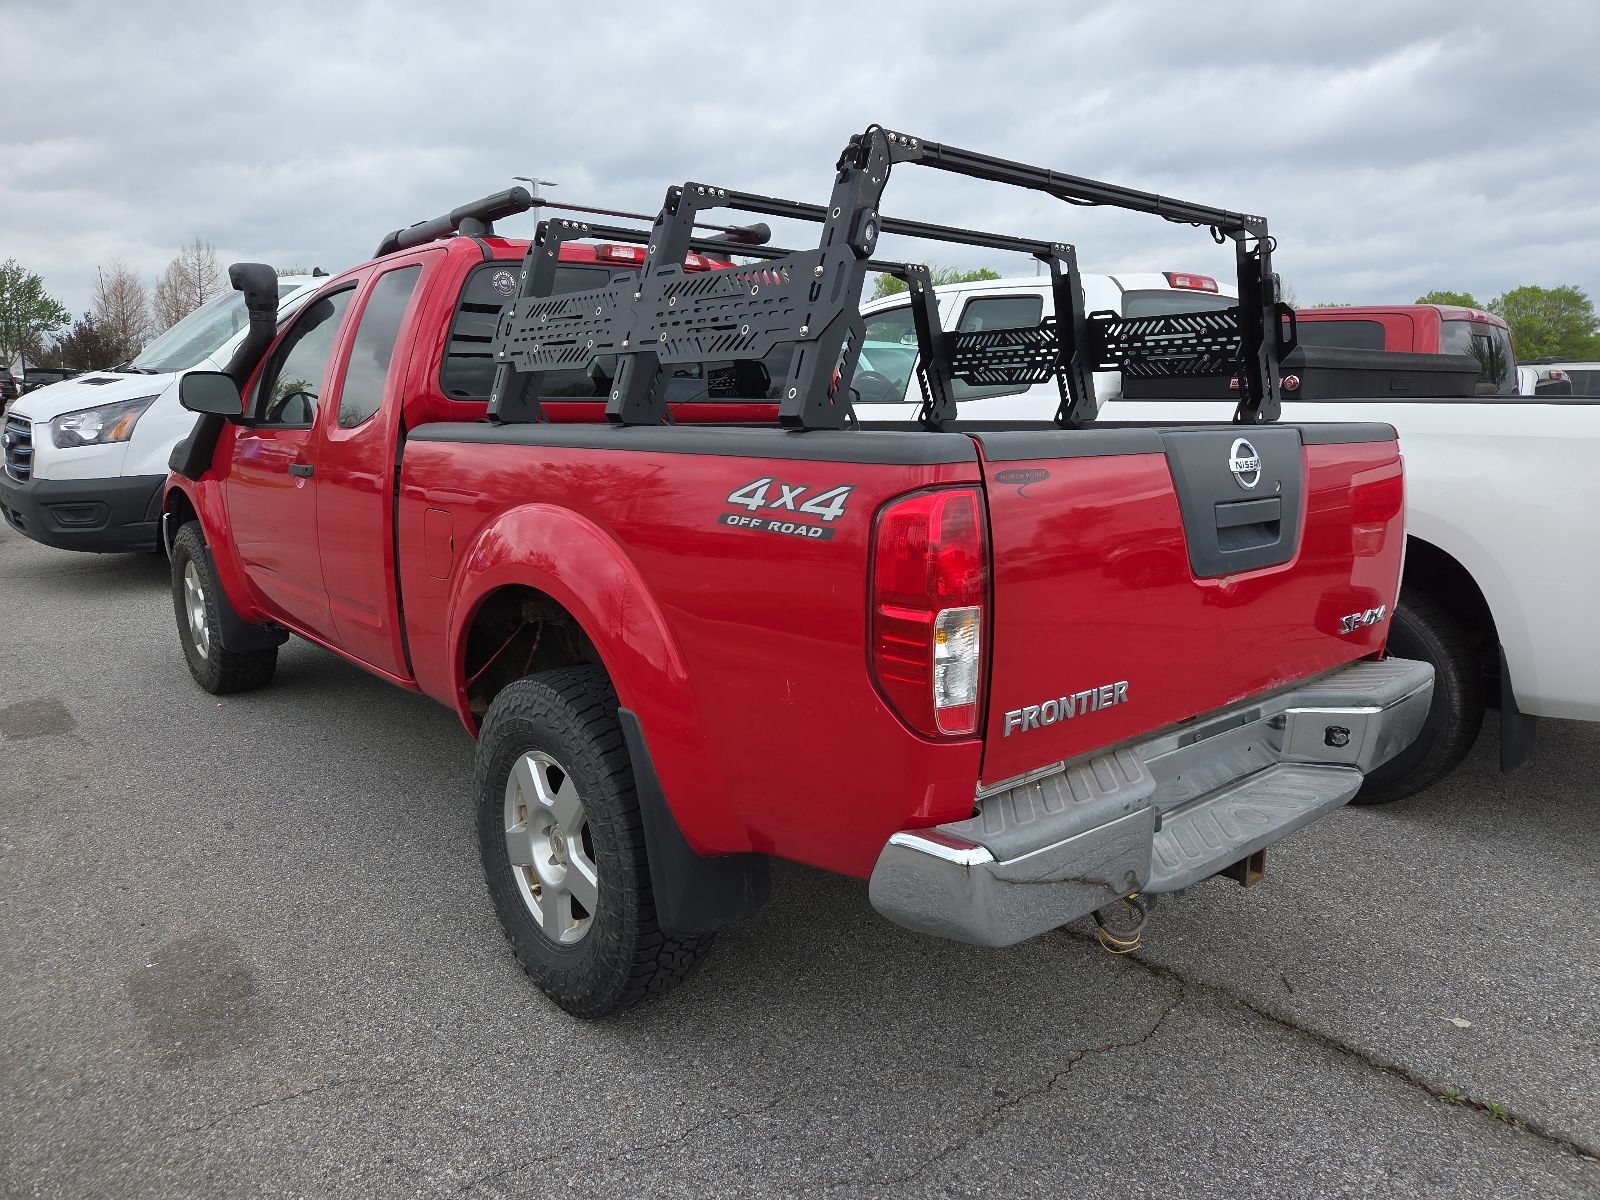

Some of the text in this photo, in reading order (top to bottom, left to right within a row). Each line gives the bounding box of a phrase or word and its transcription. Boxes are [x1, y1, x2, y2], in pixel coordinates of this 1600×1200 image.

[726, 515, 823, 538] OFF ROAD
[1003, 680, 1129, 738] FRONTIER
